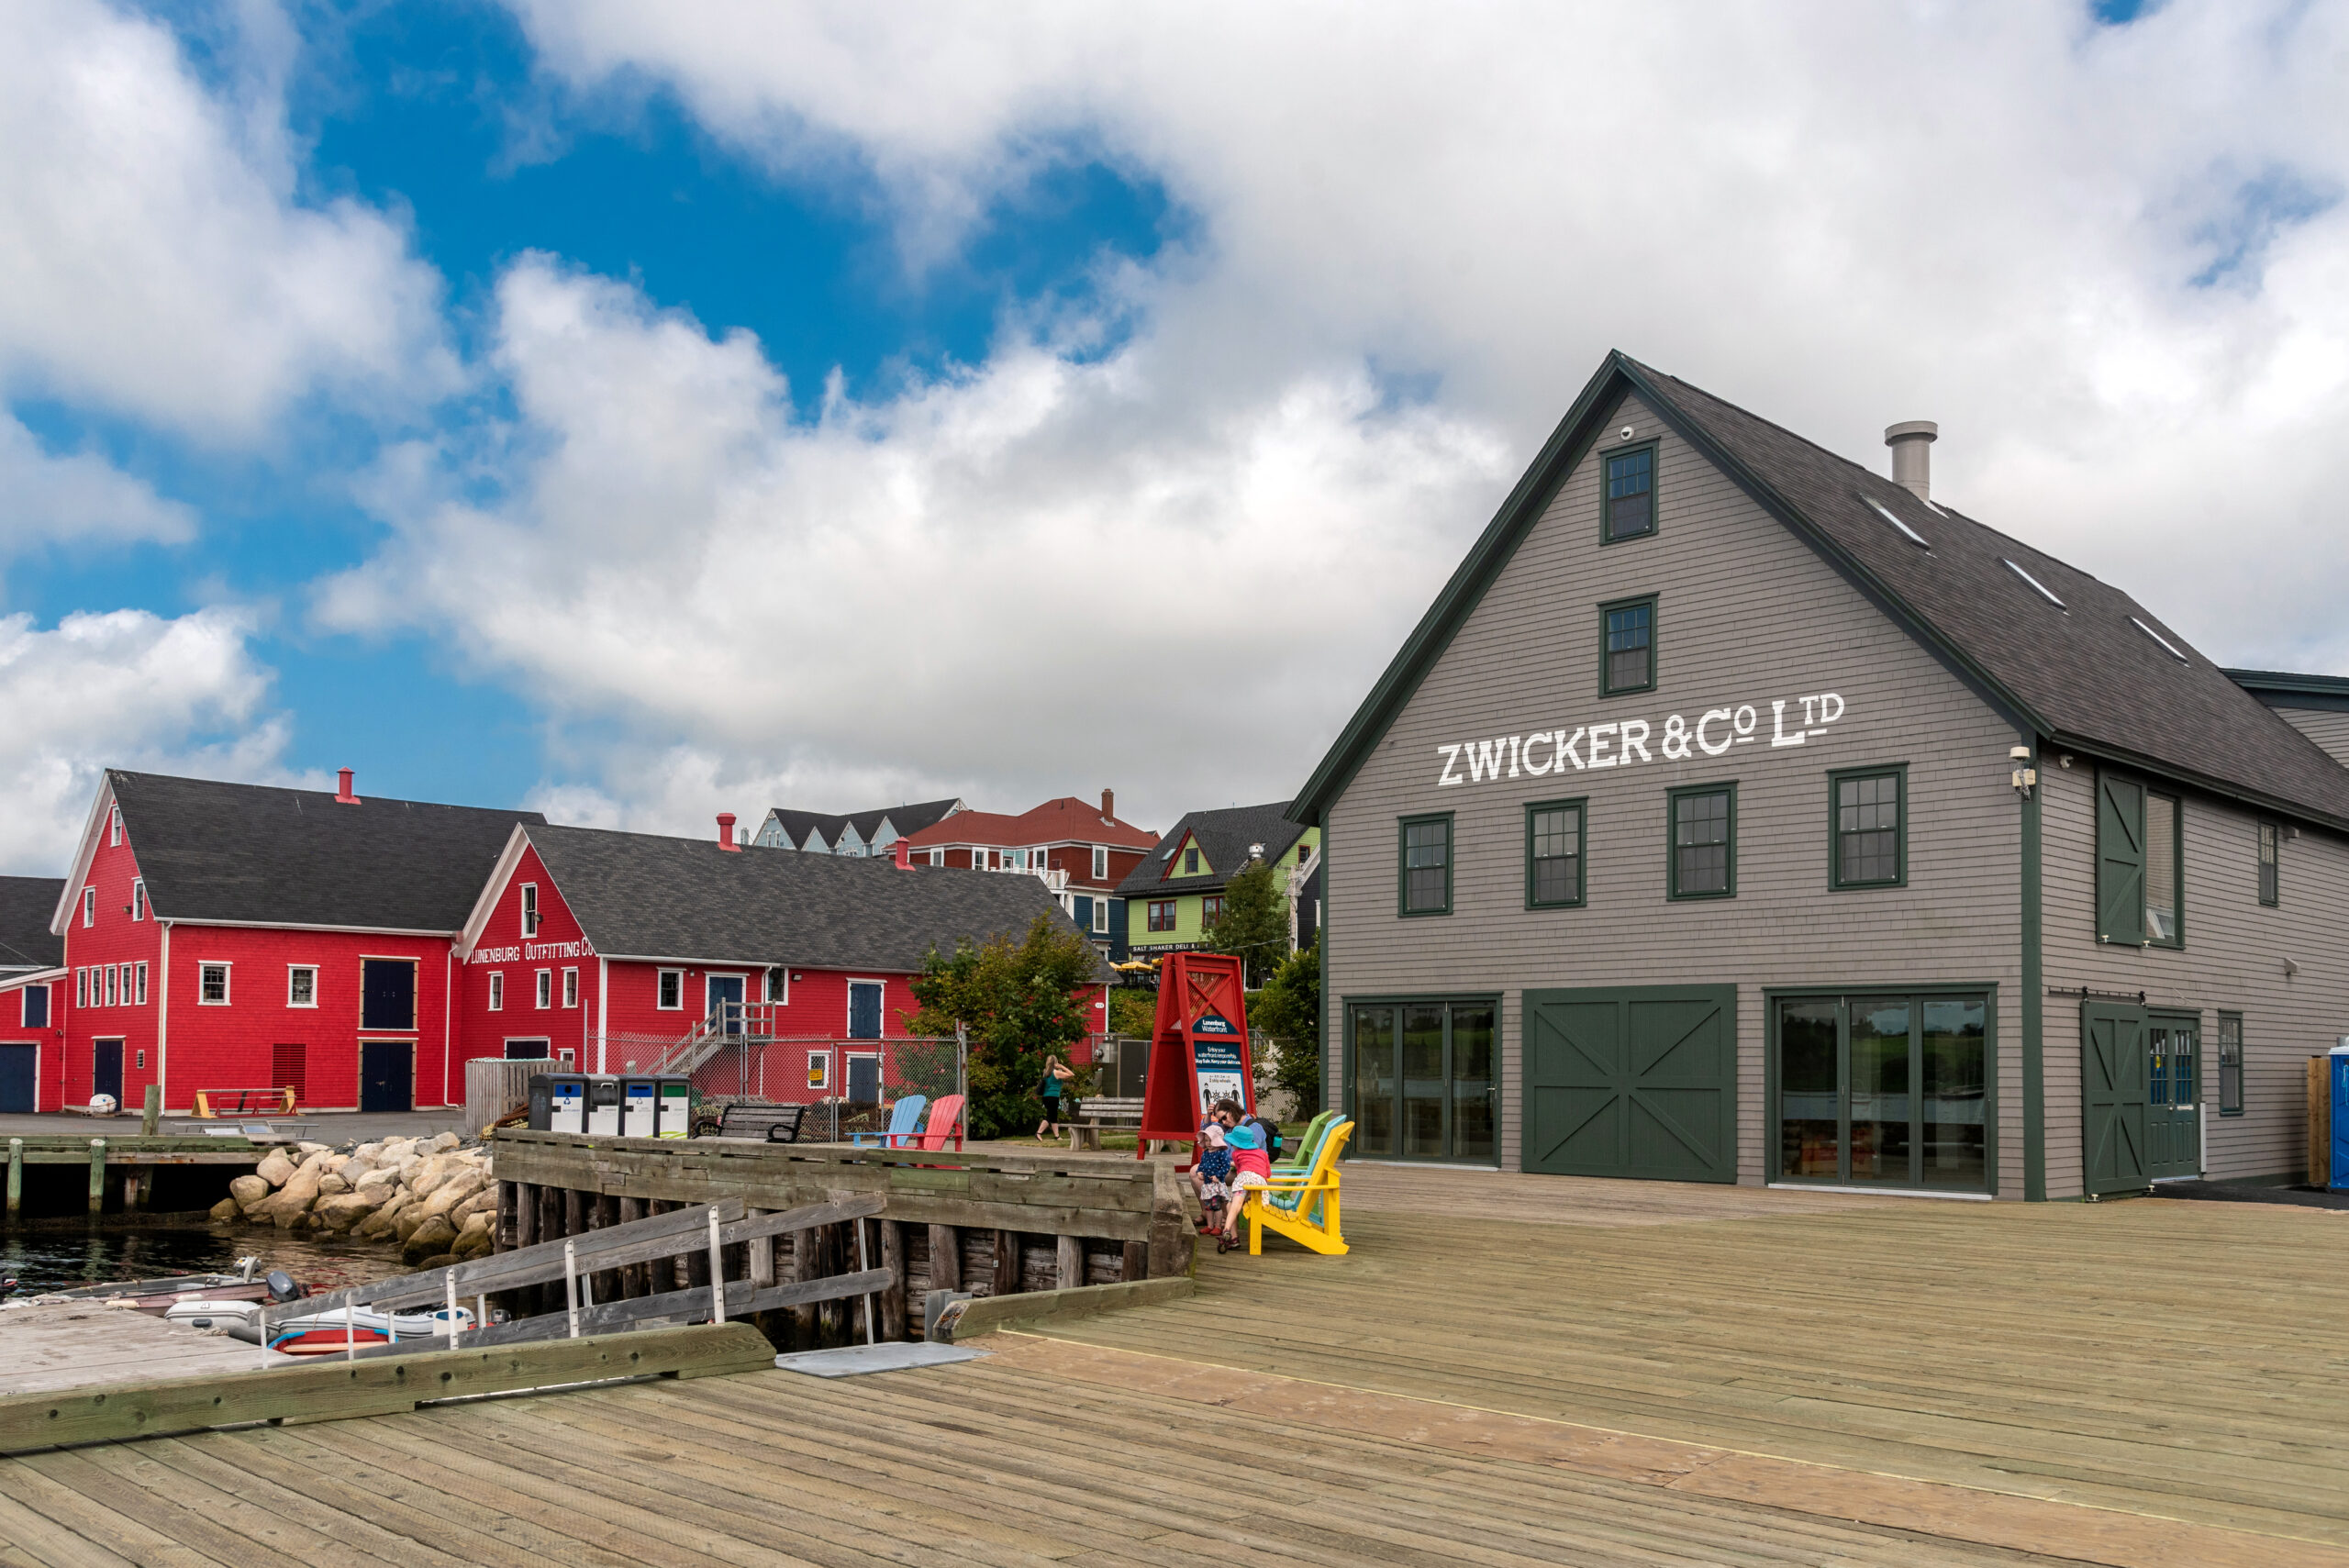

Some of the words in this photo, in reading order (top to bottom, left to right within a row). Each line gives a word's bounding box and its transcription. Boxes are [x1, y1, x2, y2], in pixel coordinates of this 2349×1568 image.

[1437, 719, 1652, 786] ZWICKER
[471, 946, 520, 964] LUNENBURG
[525, 941, 580, 961] OUTFITTING
